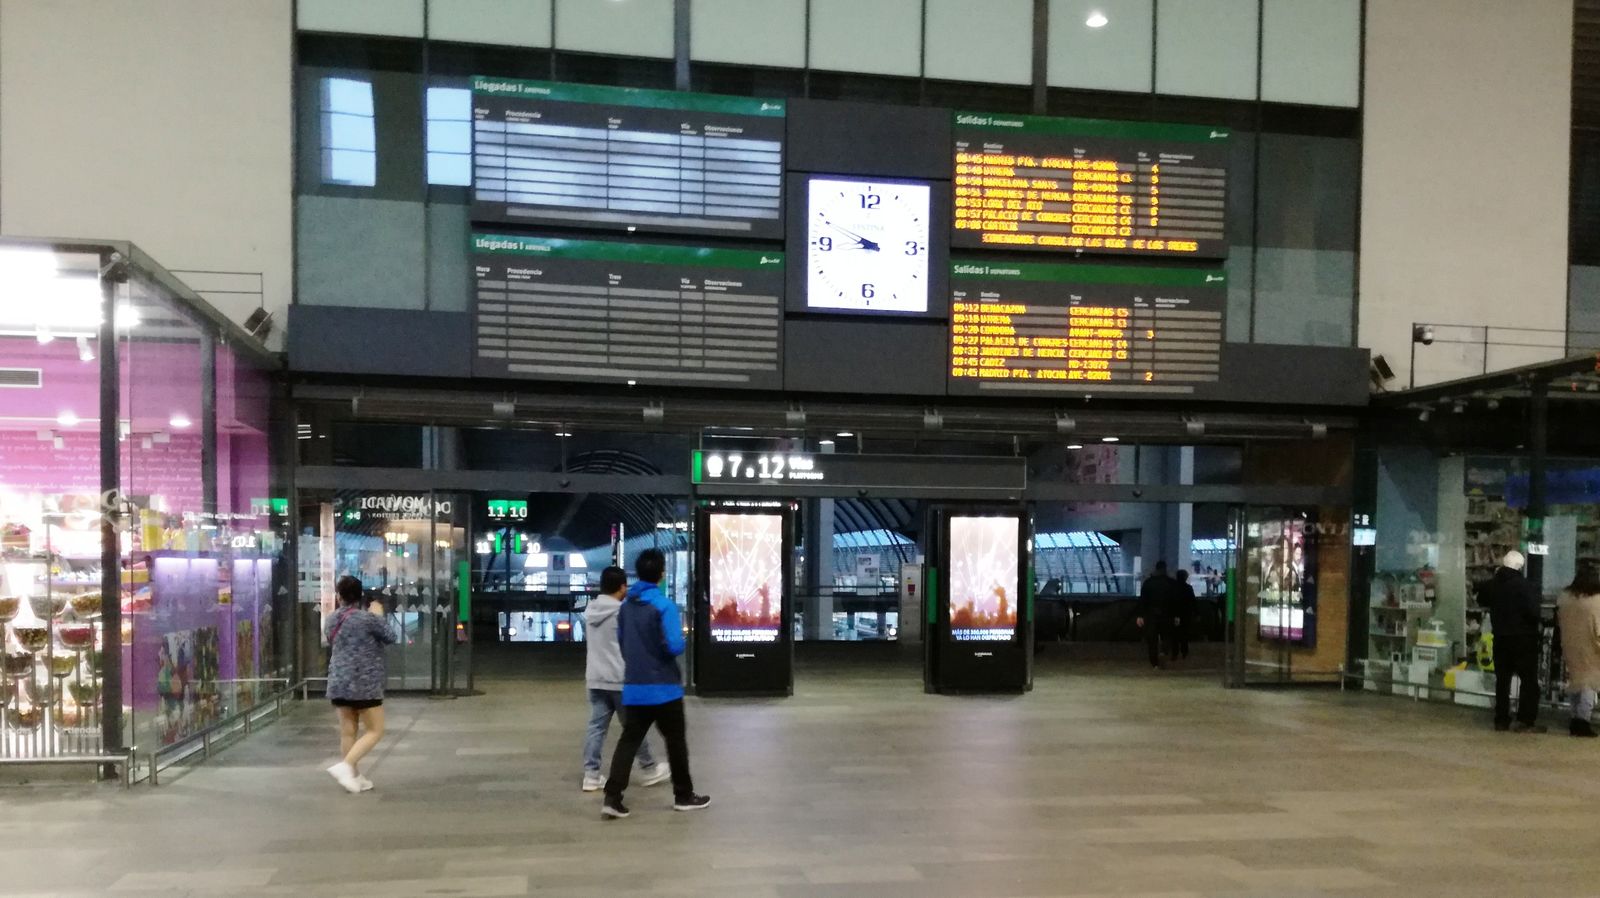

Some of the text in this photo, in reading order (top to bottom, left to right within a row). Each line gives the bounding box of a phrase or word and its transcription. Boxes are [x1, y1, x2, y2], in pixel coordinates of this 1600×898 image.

[474, 81, 517, 92] Llegadas
[858, 194, 881, 209] 12
[475, 239, 518, 250] Llegadas
[819, 237, 918, 256] 9 3
[954, 265, 984, 275] Salidas
[861, 283, 875, 299] 6
[1018, 337, 1030, 346] DE
[1022, 348, 1034, 357] DE
[1145, 372, 1153, 381] 2
[728, 455, 742, 478] 7
[758, 456, 785, 479] 12
[488, 506, 528, 518] 11 10
